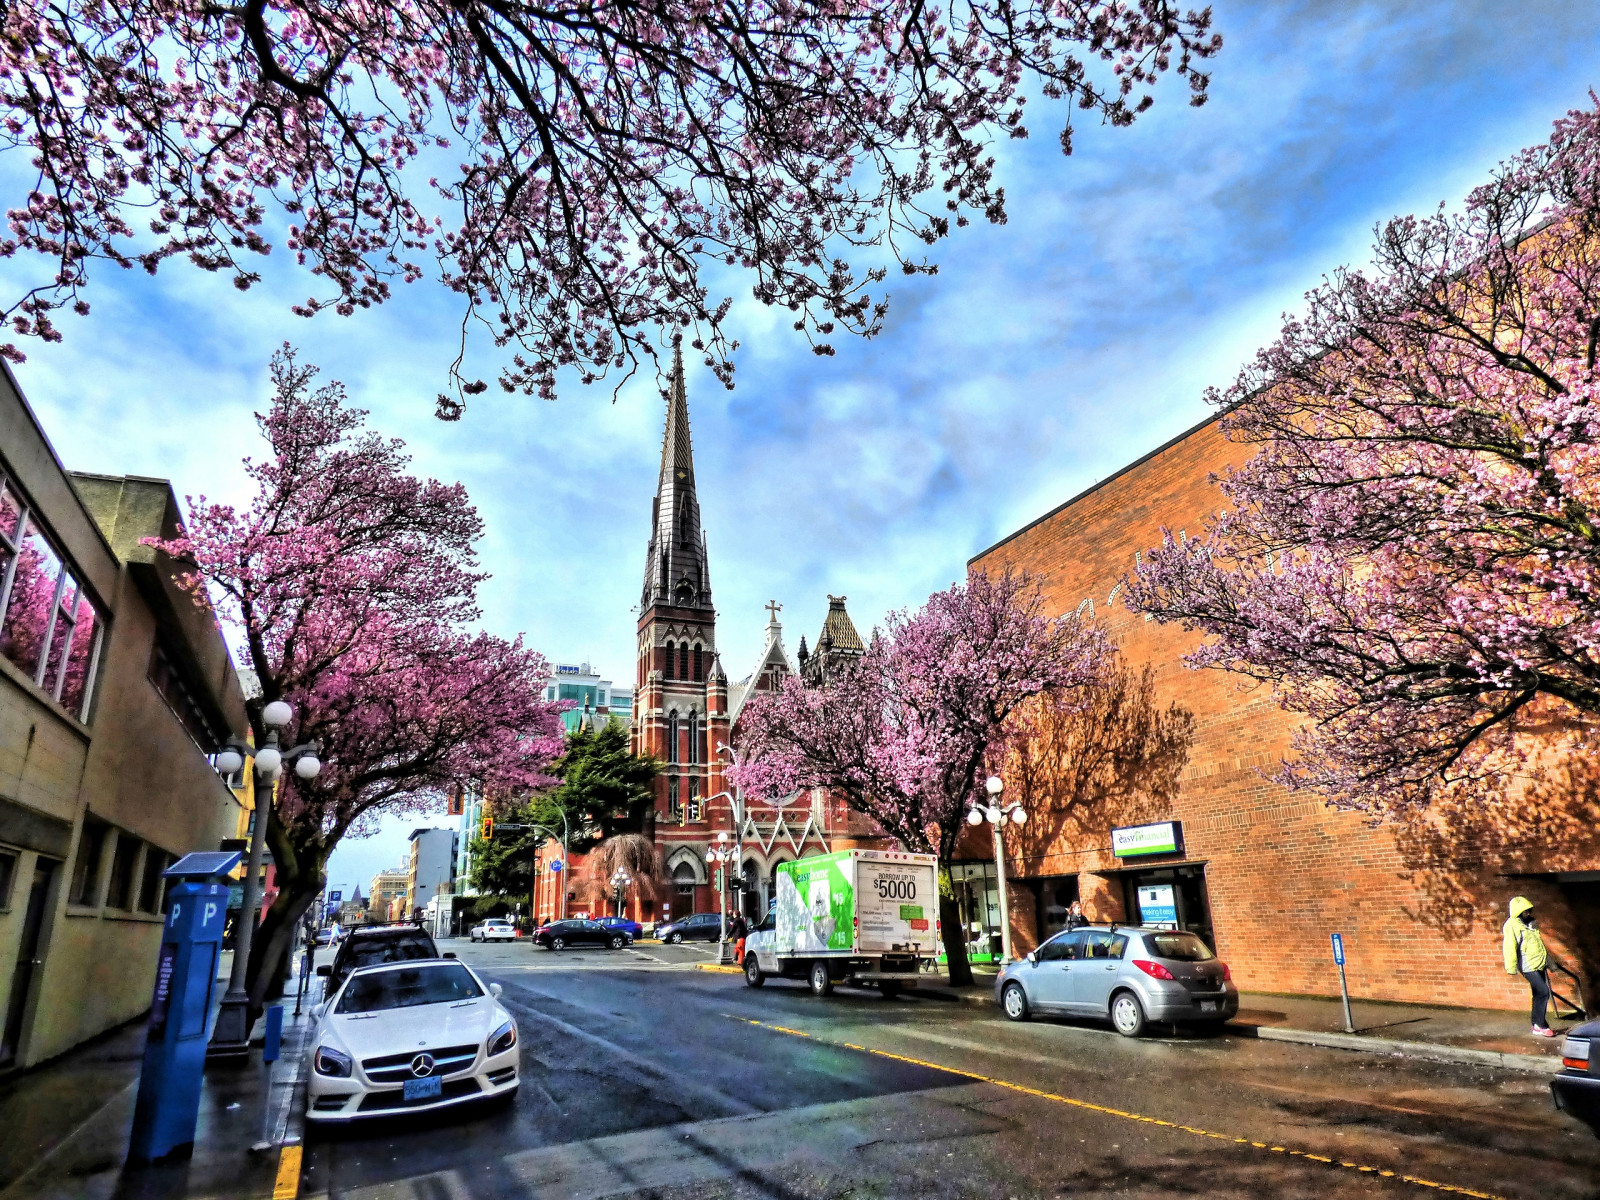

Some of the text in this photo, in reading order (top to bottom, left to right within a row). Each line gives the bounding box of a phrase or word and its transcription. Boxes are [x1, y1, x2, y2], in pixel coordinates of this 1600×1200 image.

[796, 867, 829, 883] easyhome
[878, 872, 901, 881] BORROW
[873, 878, 917, 900] $5000
[202, 902, 218, 928] P
